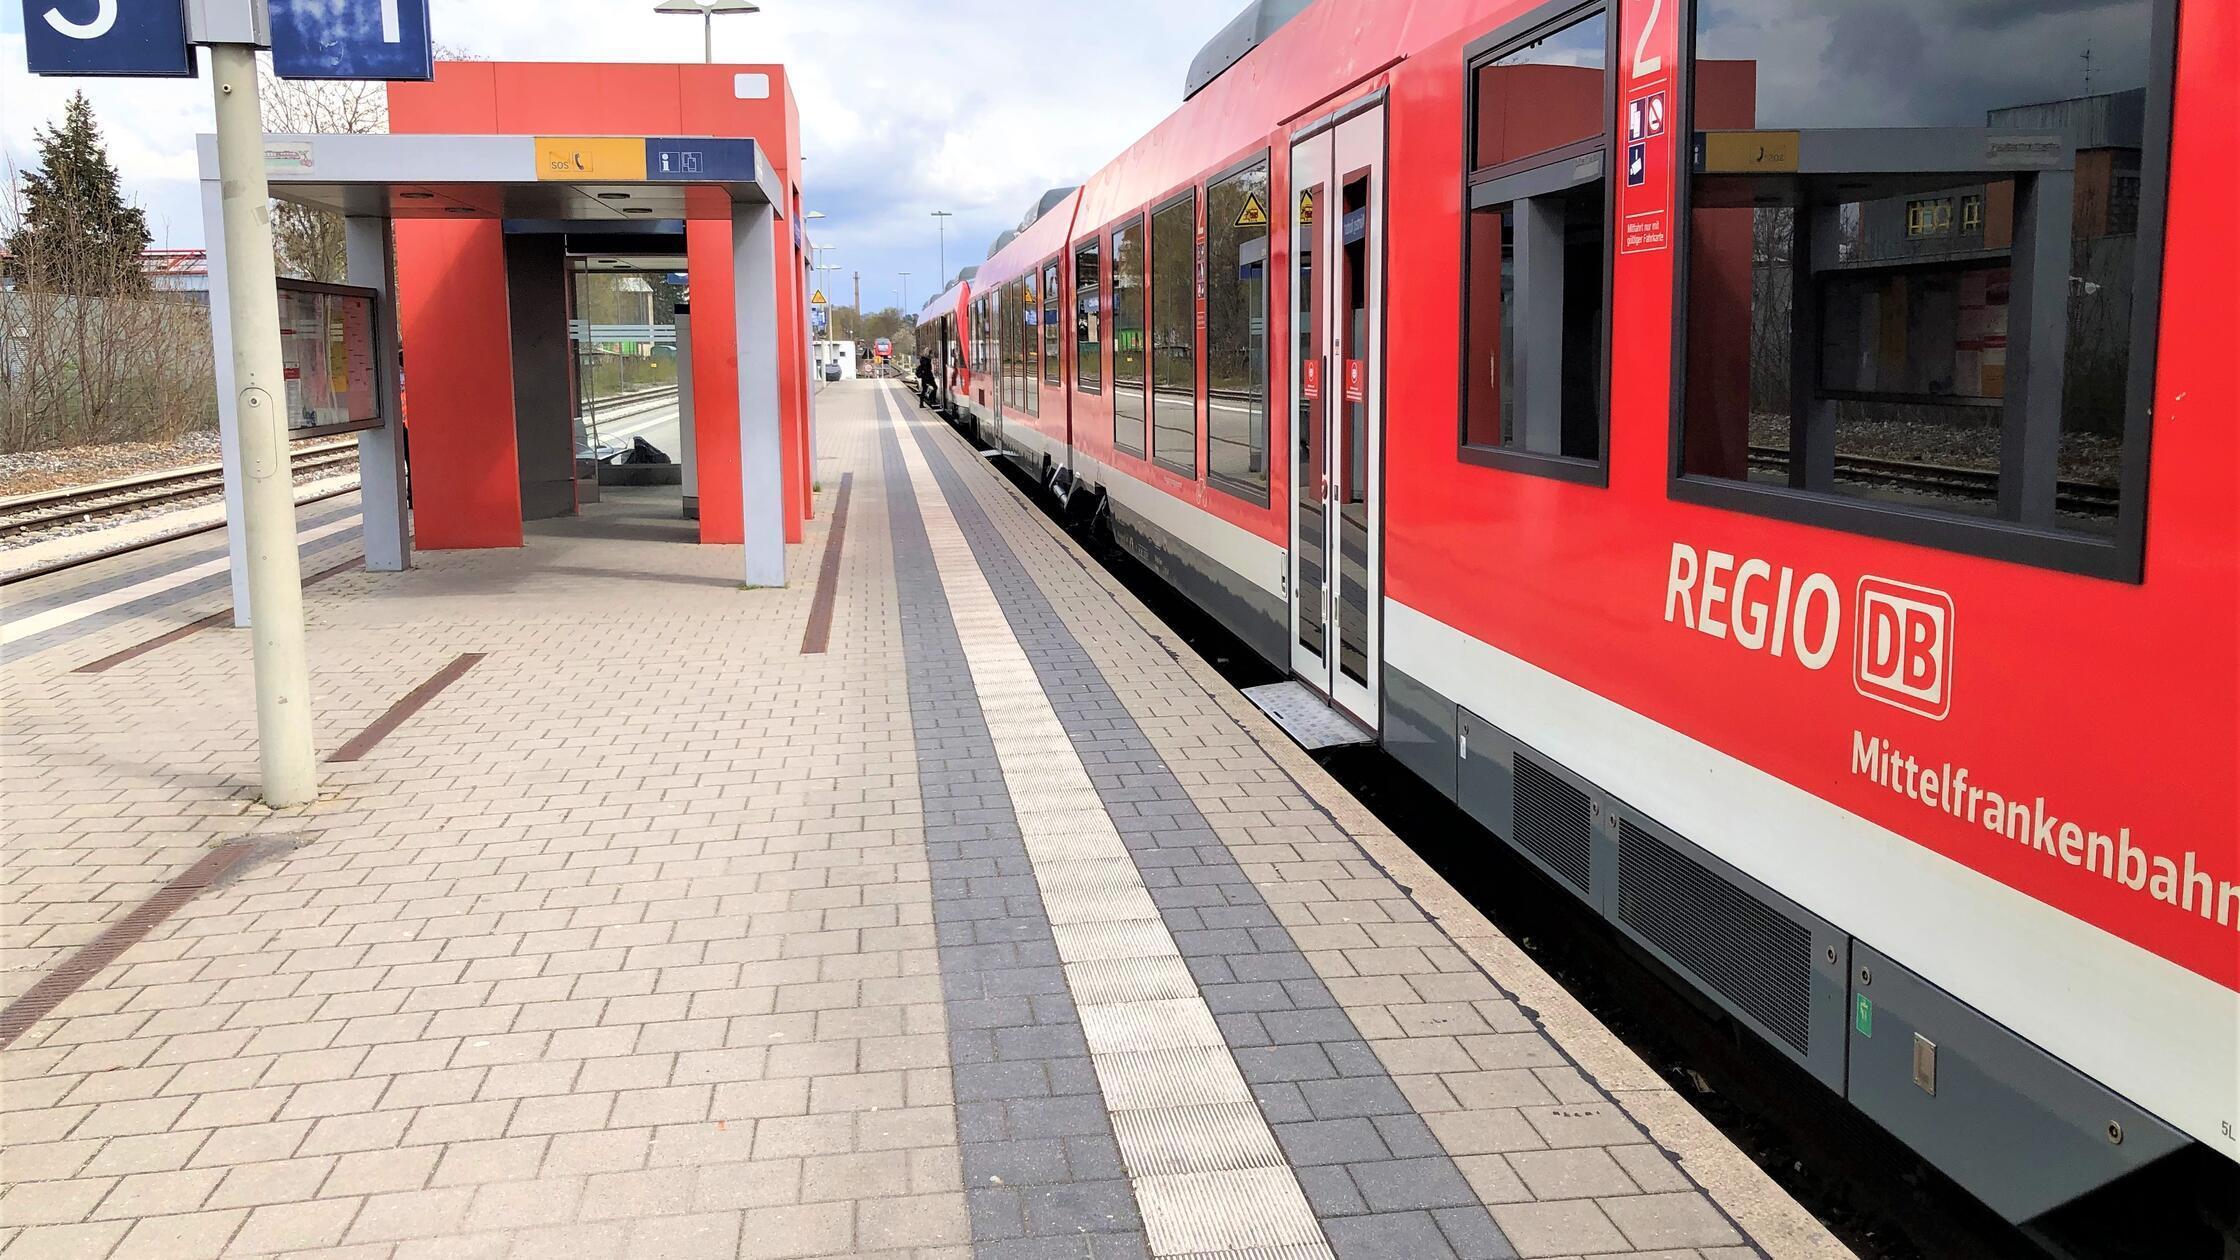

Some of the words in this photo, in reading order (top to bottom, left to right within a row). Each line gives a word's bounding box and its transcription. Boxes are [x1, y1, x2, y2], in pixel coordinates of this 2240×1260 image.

[551, 160, 569, 170] SOS
[1197, 186, 1204, 234] 2
[1664, 542, 1840, 670] REGIO
[1866, 599, 1937, 690] DB
[1852, 730, 2240, 931] Mittelfrankenbahn
[2221, 1120, 2236, 1142] 5L
